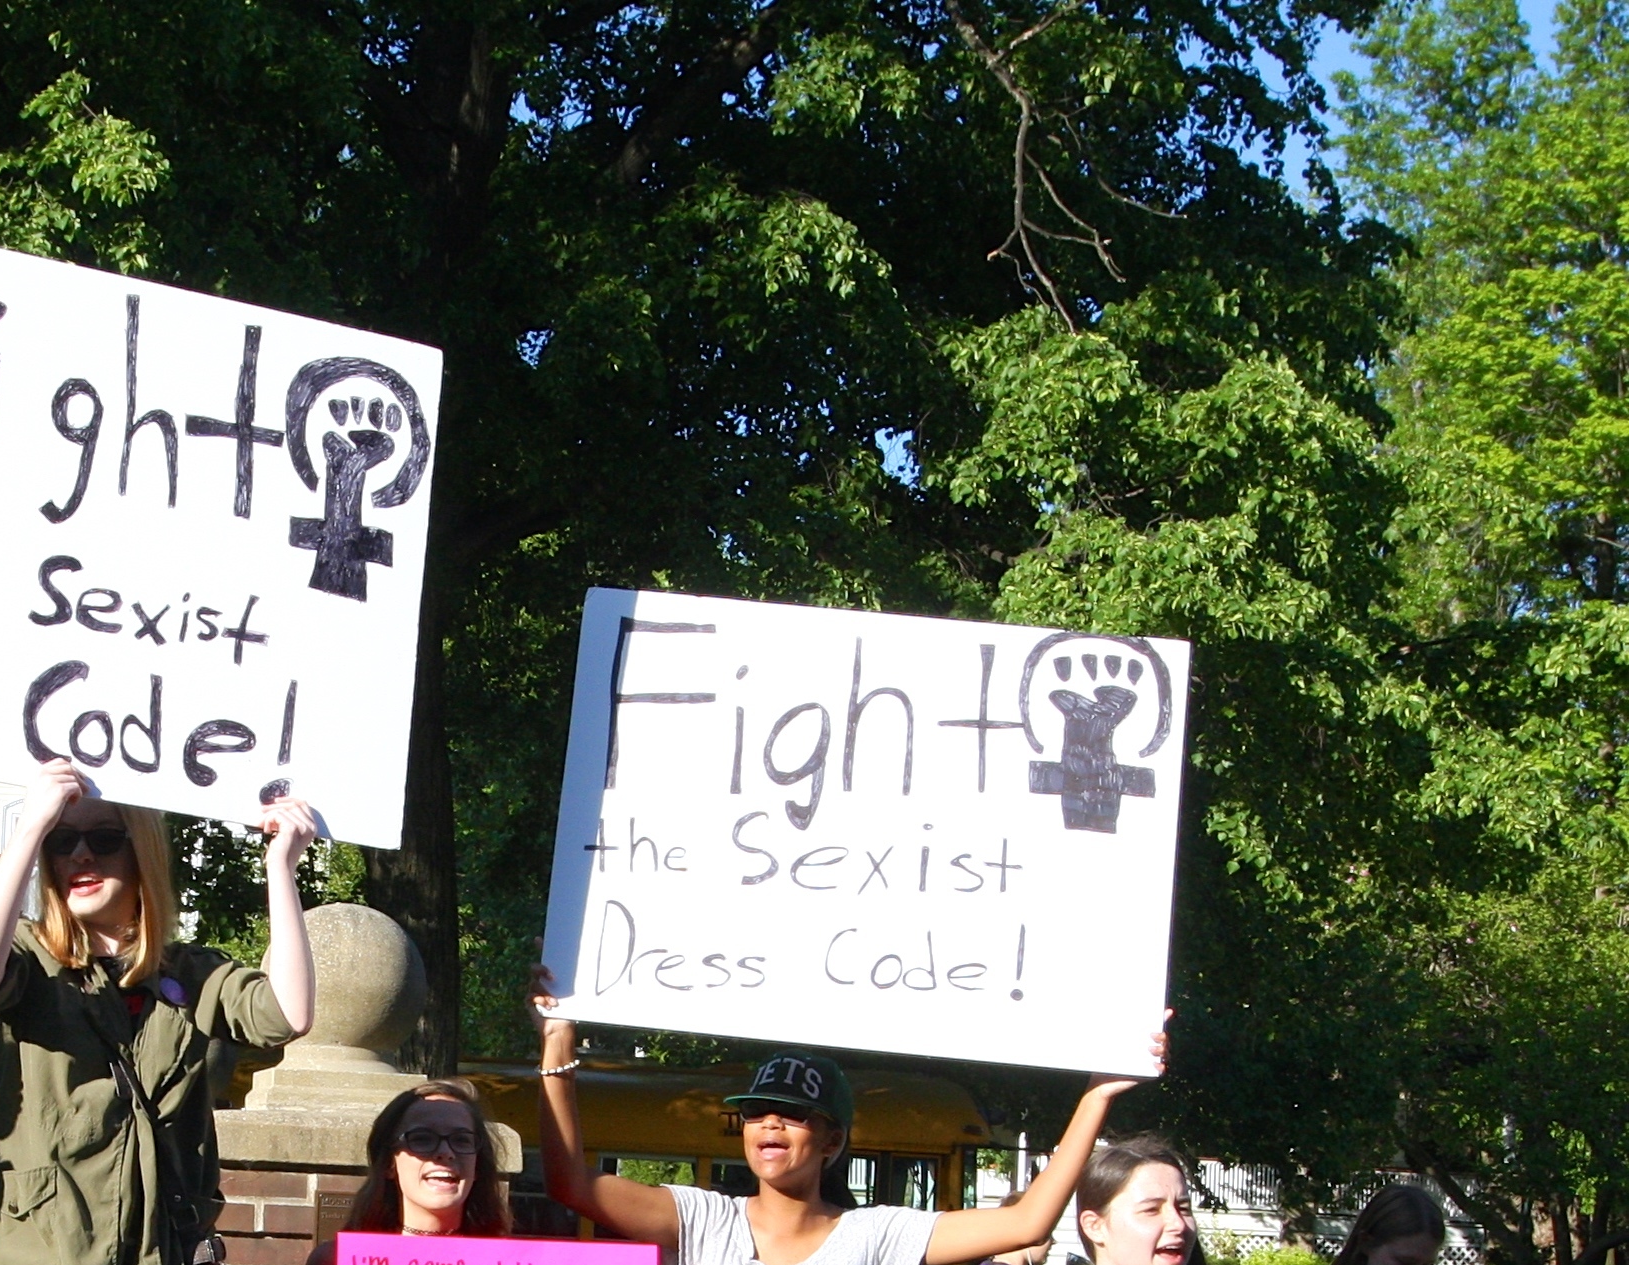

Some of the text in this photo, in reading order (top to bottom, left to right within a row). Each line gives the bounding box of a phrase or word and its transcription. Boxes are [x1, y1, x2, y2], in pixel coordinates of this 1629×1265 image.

[28, 555, 270, 665] Sexist
[23, 660, 299, 806] Code!
[603, 615, 1026, 830] Fight
[583, 811, 1023, 896] the Sexist
[595, 899, 1026, 1002] Dress Code!
[749, 1057, 823, 1099] JETS
